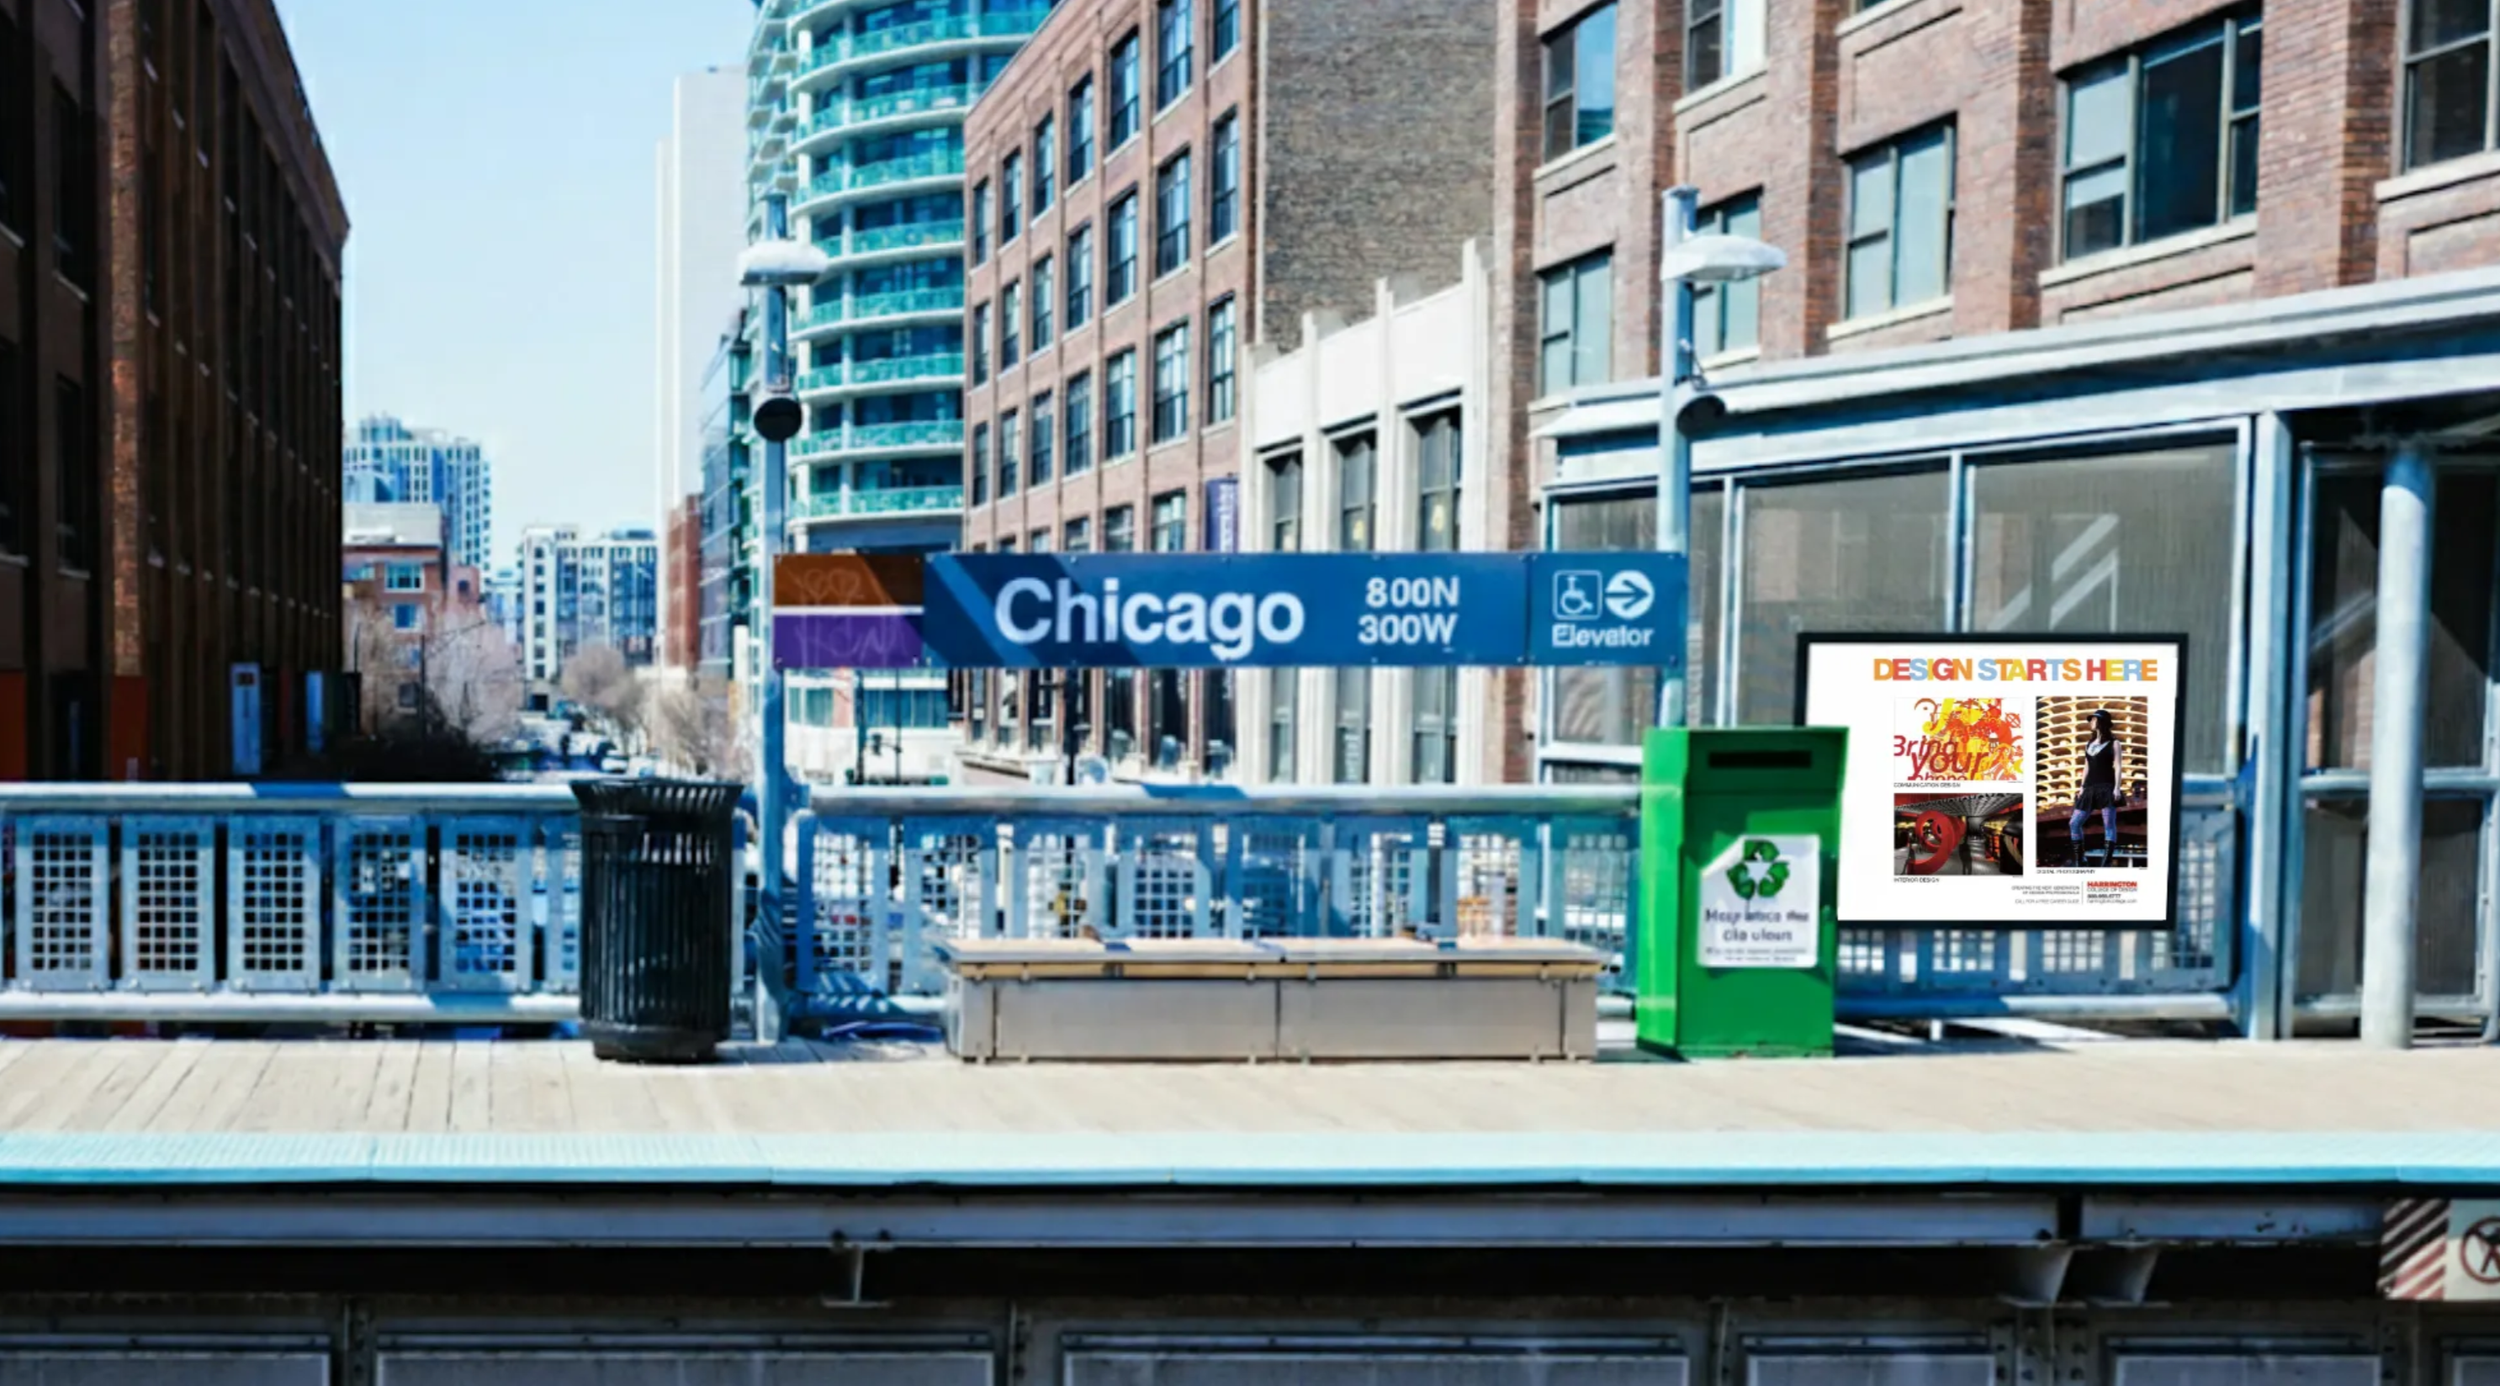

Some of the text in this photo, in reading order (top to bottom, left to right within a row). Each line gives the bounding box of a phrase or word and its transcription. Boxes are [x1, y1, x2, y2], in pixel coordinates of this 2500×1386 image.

[1366, 577, 1459, 608] 800N
[995, 577, 1304, 661] Chicago
[1358, 613, 1457, 644] 300W
[1552, 623, 1653, 647] Elevator
[1873, 658, 2158, 682] DESIGN STARTS HERE
[1909, 751, 1988, 780] your
